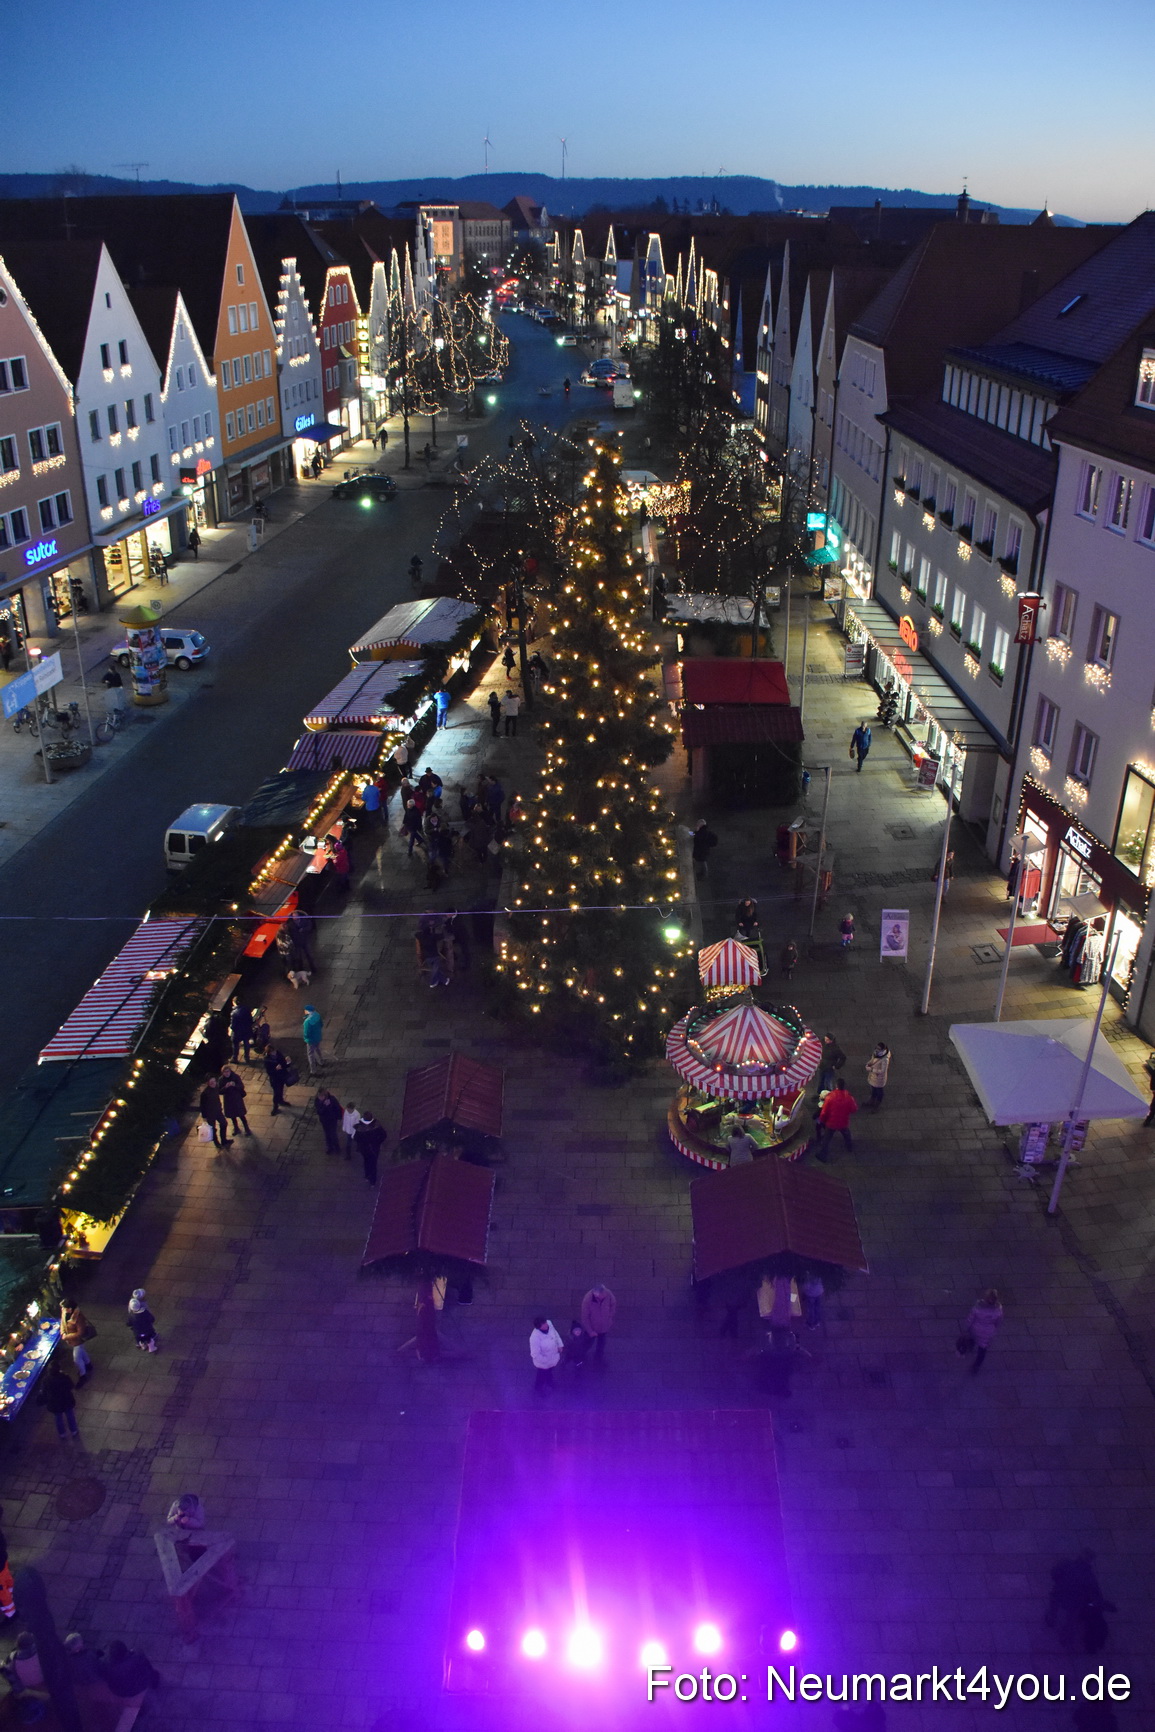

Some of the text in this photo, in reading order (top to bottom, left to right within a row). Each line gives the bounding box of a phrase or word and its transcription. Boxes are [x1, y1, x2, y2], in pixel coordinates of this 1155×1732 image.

[357, 318, 370, 375] HOTEL
[1019, 604, 1035, 640] Achatz
[1064, 826, 1092, 859] Achatz
